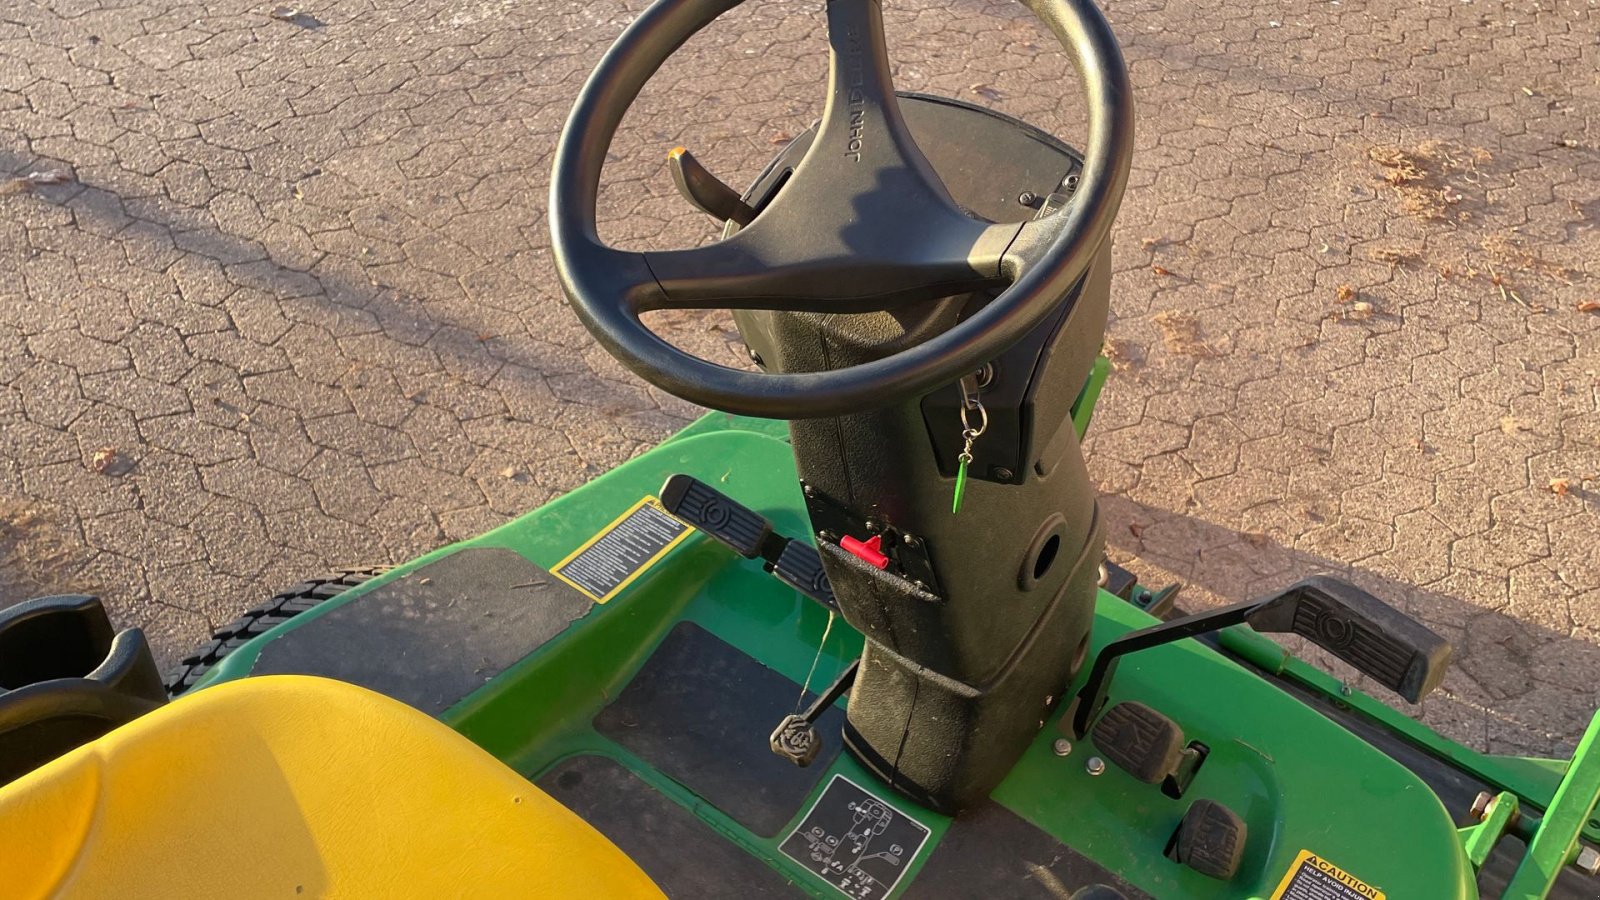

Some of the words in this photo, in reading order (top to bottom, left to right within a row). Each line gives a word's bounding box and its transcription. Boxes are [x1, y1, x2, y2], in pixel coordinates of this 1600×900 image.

[847, 24, 865, 106] DEERE
[844, 111, 865, 163] JOHN
[1304, 866, 1322, 878] HELP
[1322, 876, 1344, 891] AVOID
[1344, 888, 1367, 900] INJUR
[1318, 861, 1378, 899] CAUTION
